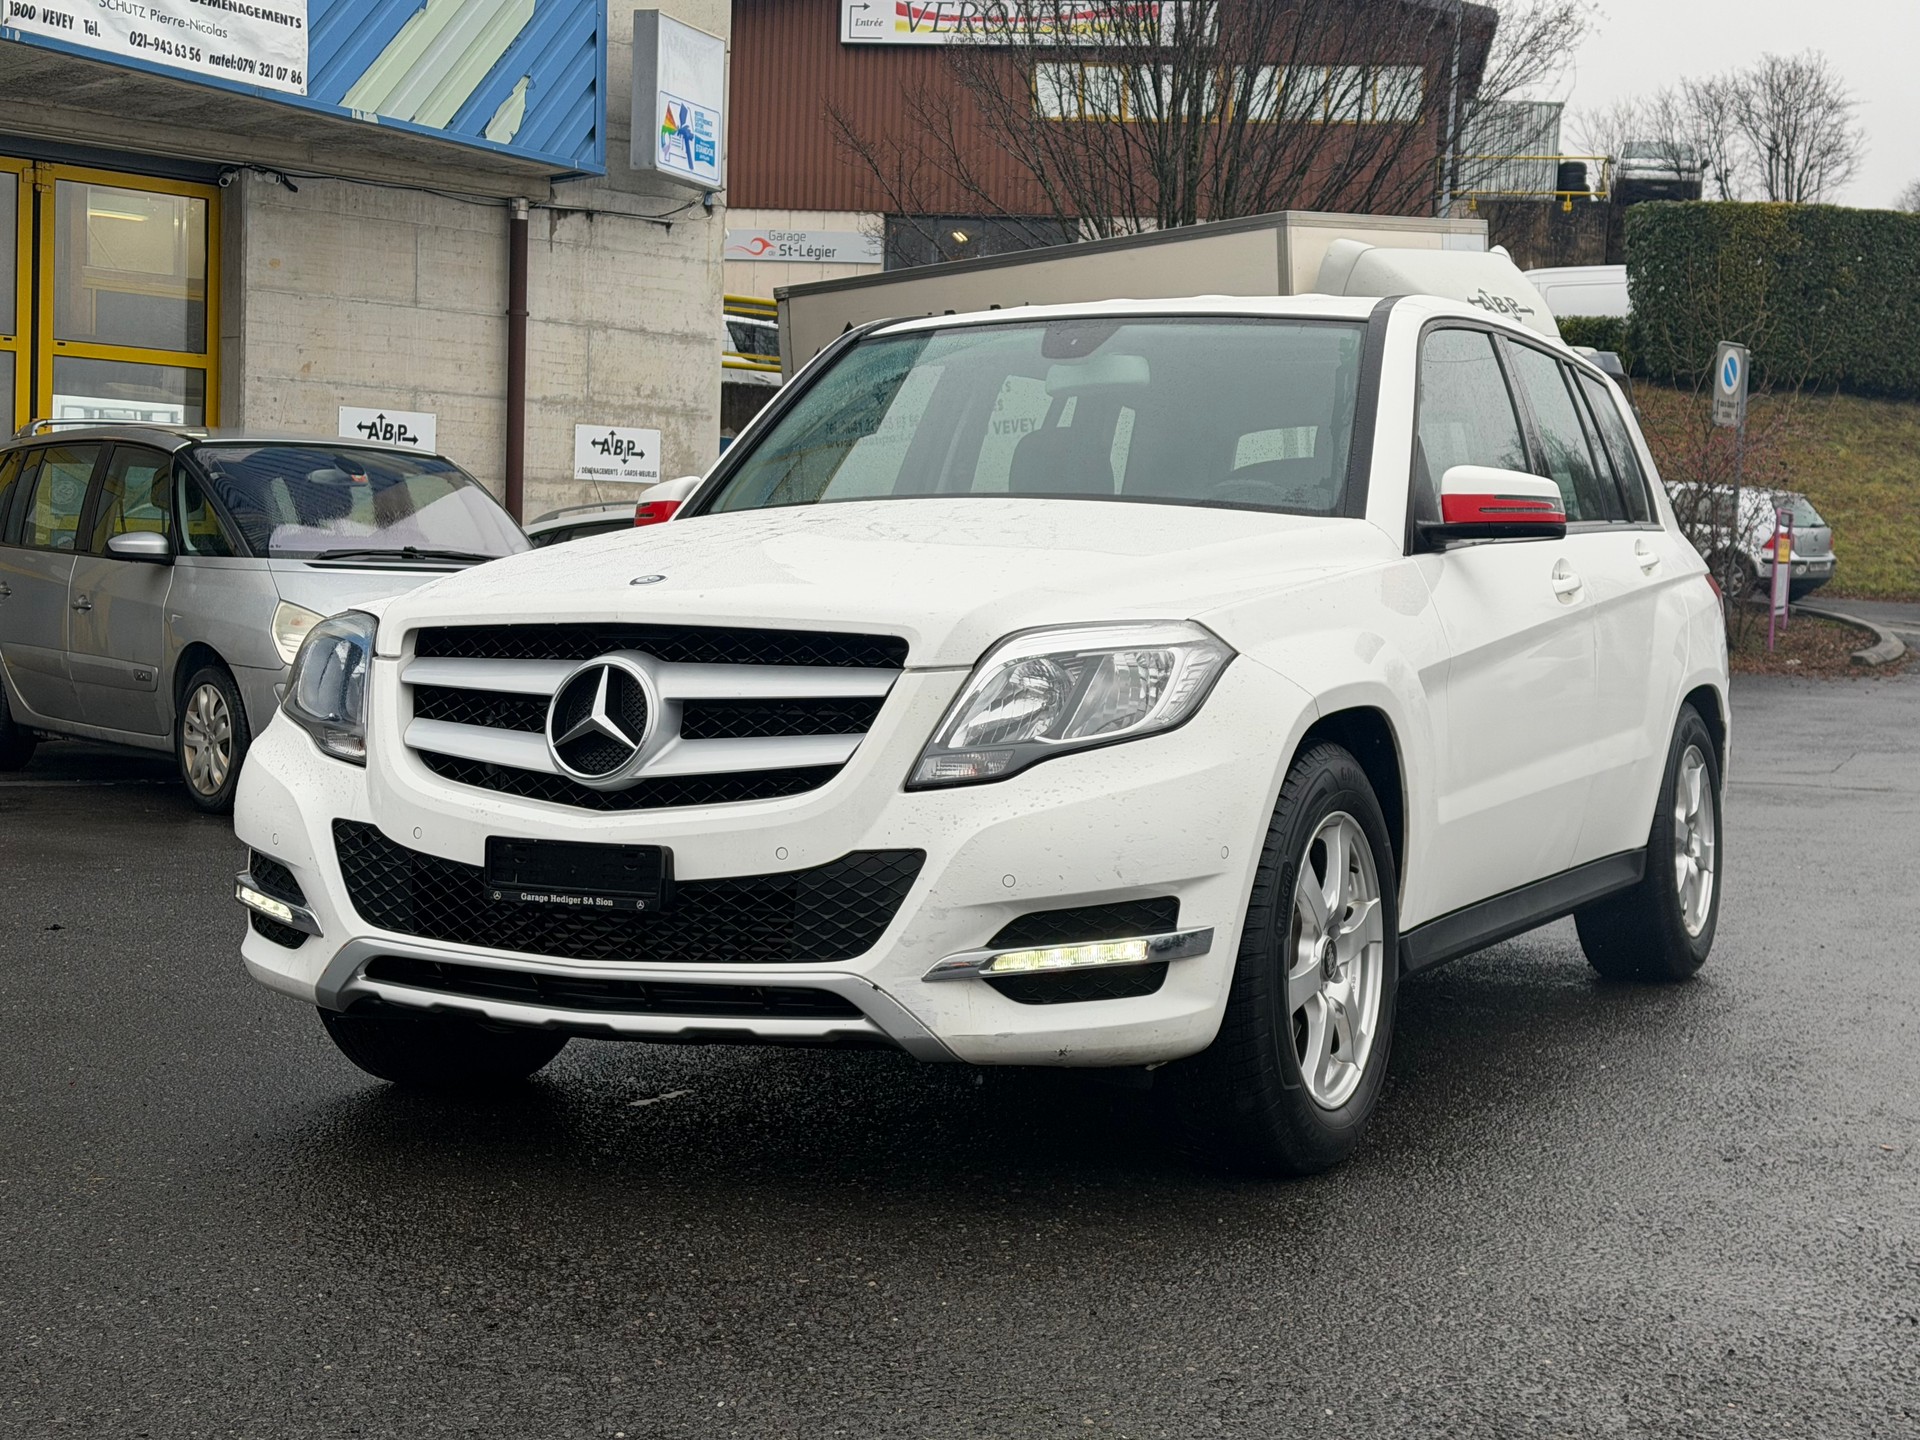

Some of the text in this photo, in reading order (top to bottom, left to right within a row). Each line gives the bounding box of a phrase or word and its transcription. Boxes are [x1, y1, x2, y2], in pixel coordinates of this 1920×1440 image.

[189, 0, 302, 29] MENAGEMENTS
[855, 18, 884, 27] Entrée
[150, 8, 228, 39] Pierre-Nicolas
[9, 0, 37, 20] 1800
[42, 8, 75, 30] VEVEY
[83, 19, 101, 38] Tél.
[259, 62, 274, 79] 321
[276, 66, 288, 81] 07
[290, 70, 302, 85] 86
[768, 230, 807, 244] Garage
[779, 244, 837, 260] St-Légier
[367, 421, 408, 442] ABP
[993, 418, 1036, 434] VEVEY
[600, 438, 636, 457] ABP
[520, 892, 614, 906] Garage Hediger SA Sion
